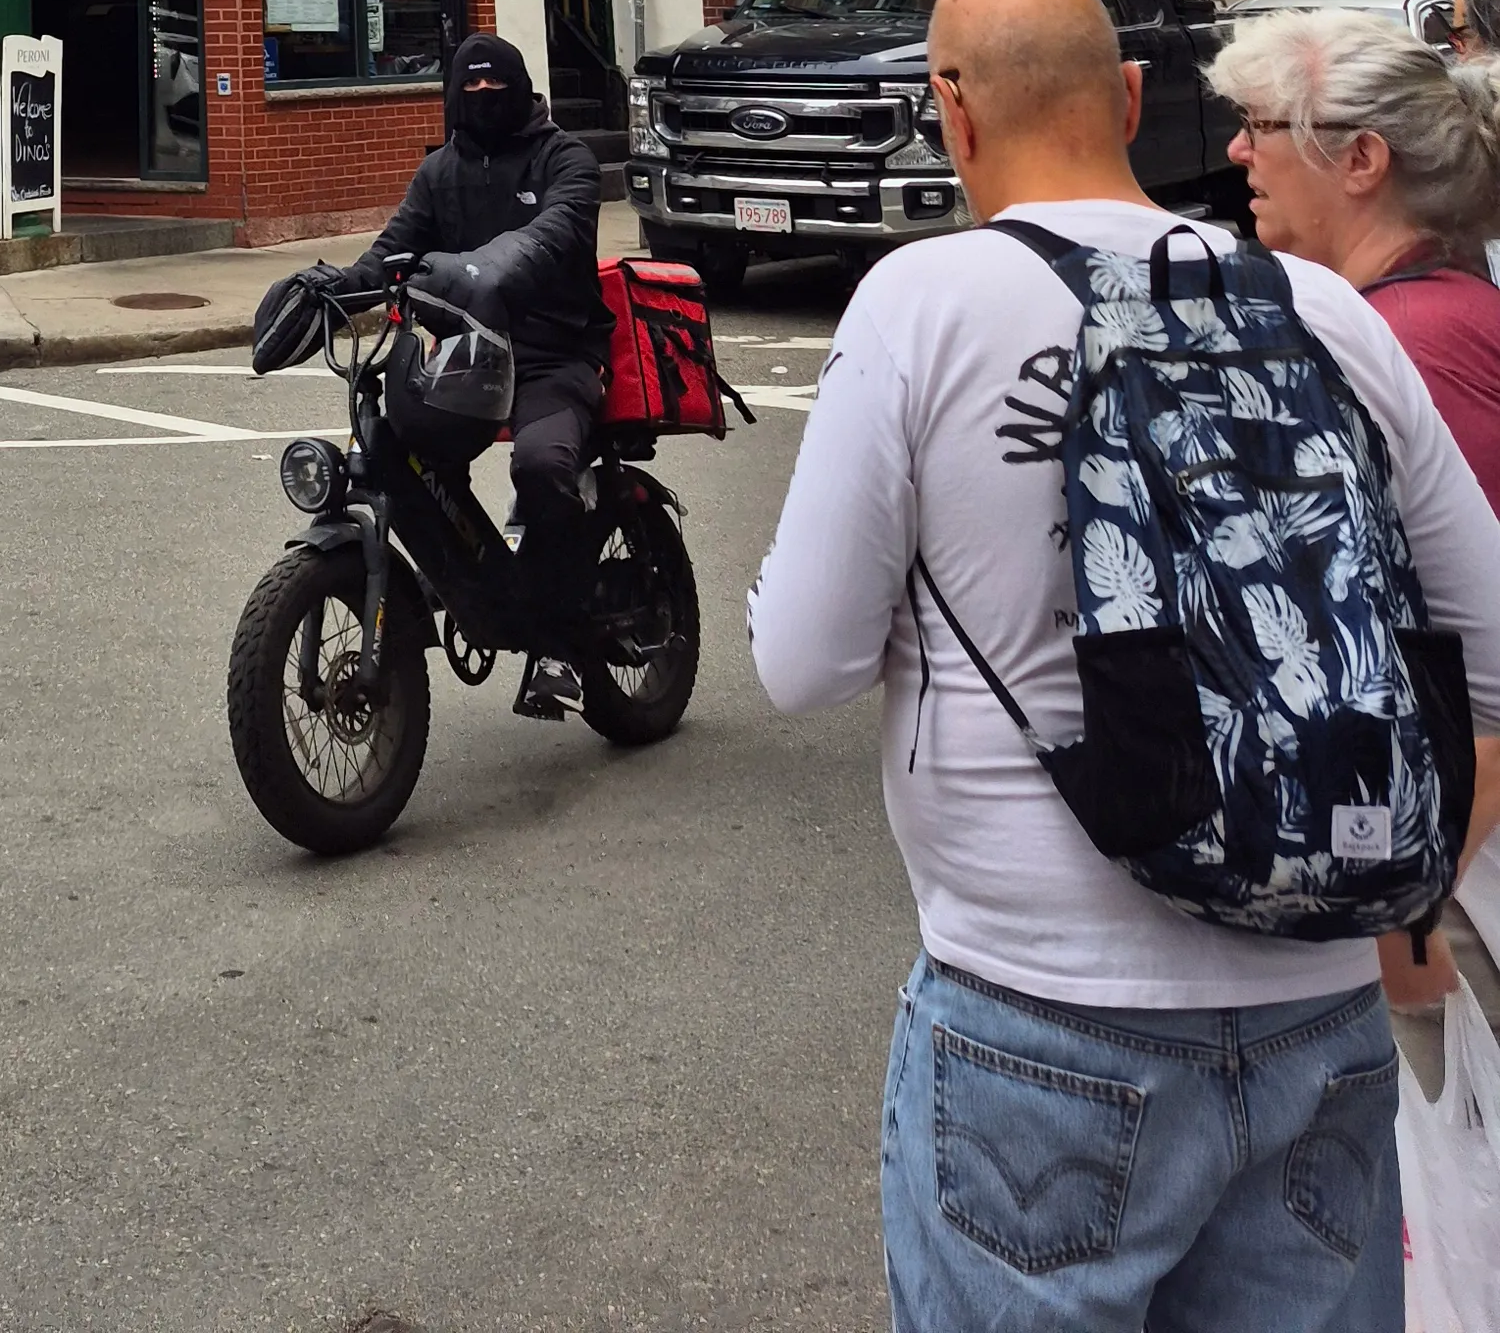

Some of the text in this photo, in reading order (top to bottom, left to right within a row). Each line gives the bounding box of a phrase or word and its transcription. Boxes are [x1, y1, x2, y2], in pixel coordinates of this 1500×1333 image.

[17, 49, 50, 63] PERONI
[24, 120, 33, 139] to
[743, 116, 773, 130] Ford
